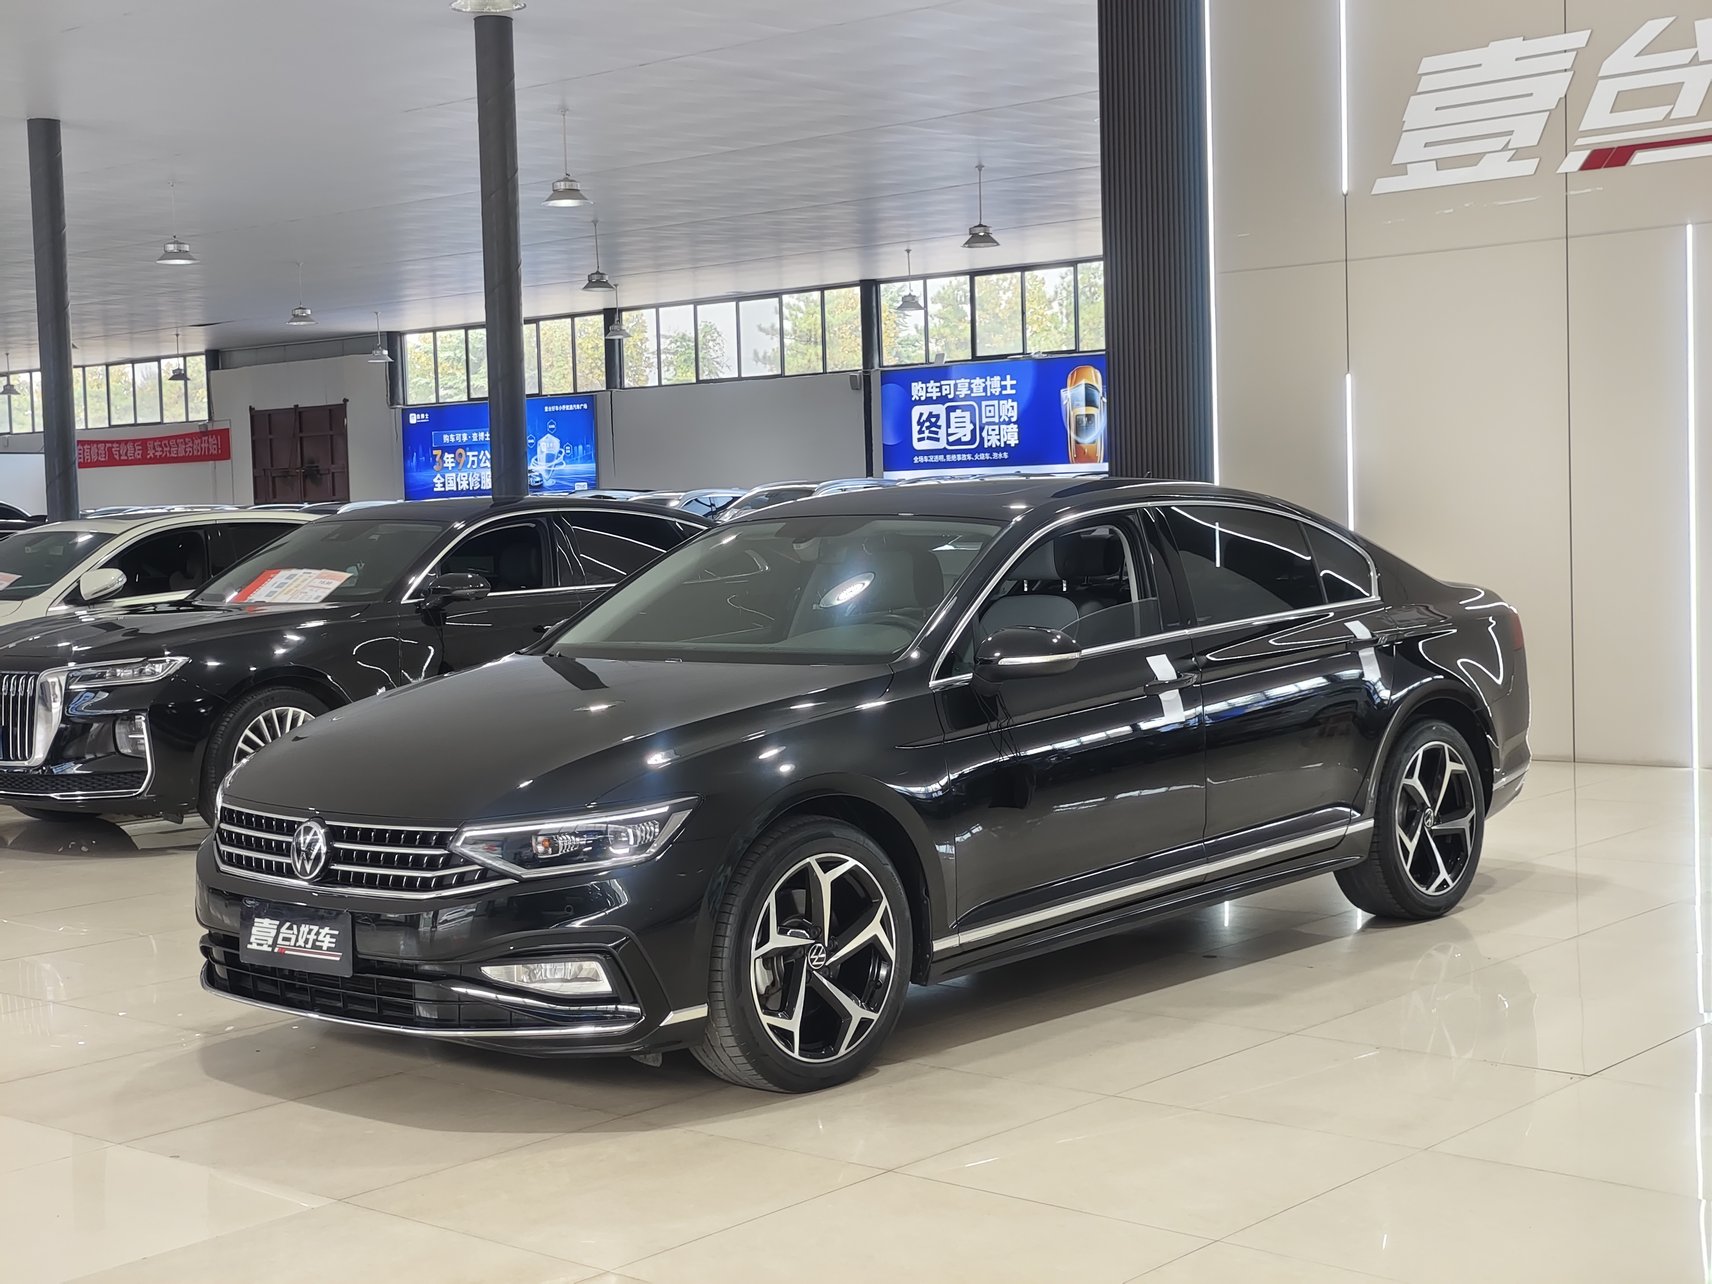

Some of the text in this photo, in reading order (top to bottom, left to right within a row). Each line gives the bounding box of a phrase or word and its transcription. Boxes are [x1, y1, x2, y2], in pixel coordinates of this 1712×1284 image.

[911, 375, 1017, 401] 购车可享查博士
[916, 399, 1018, 444] 终身 回购
[982, 424, 1020, 448] 保障
[247, 917, 339, 952] 壹台好车
